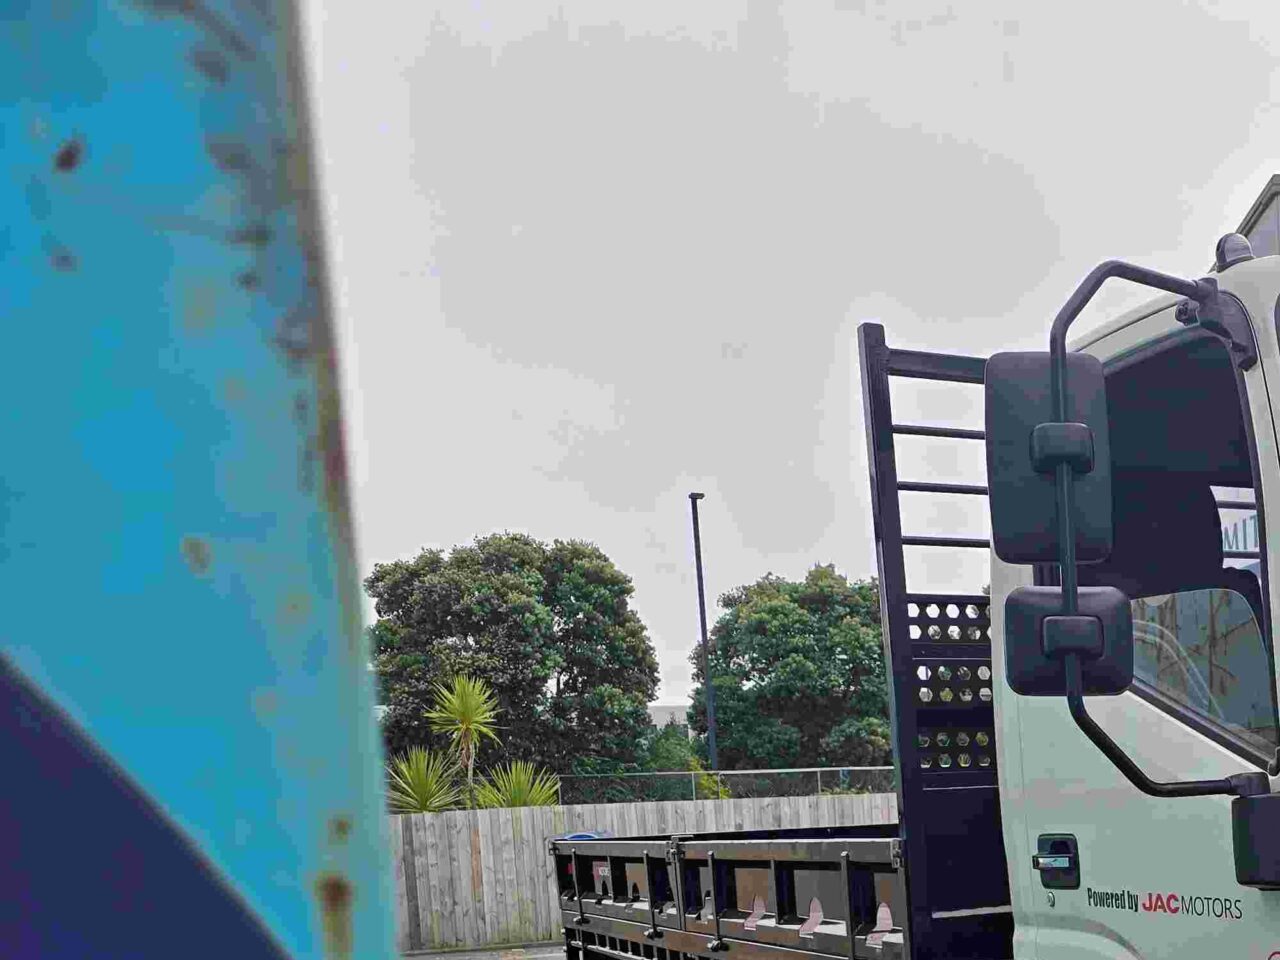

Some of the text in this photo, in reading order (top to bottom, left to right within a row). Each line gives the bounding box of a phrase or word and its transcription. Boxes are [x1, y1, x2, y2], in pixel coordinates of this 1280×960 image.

[1087, 887, 1243, 919] Powered by JAC MOTORS
